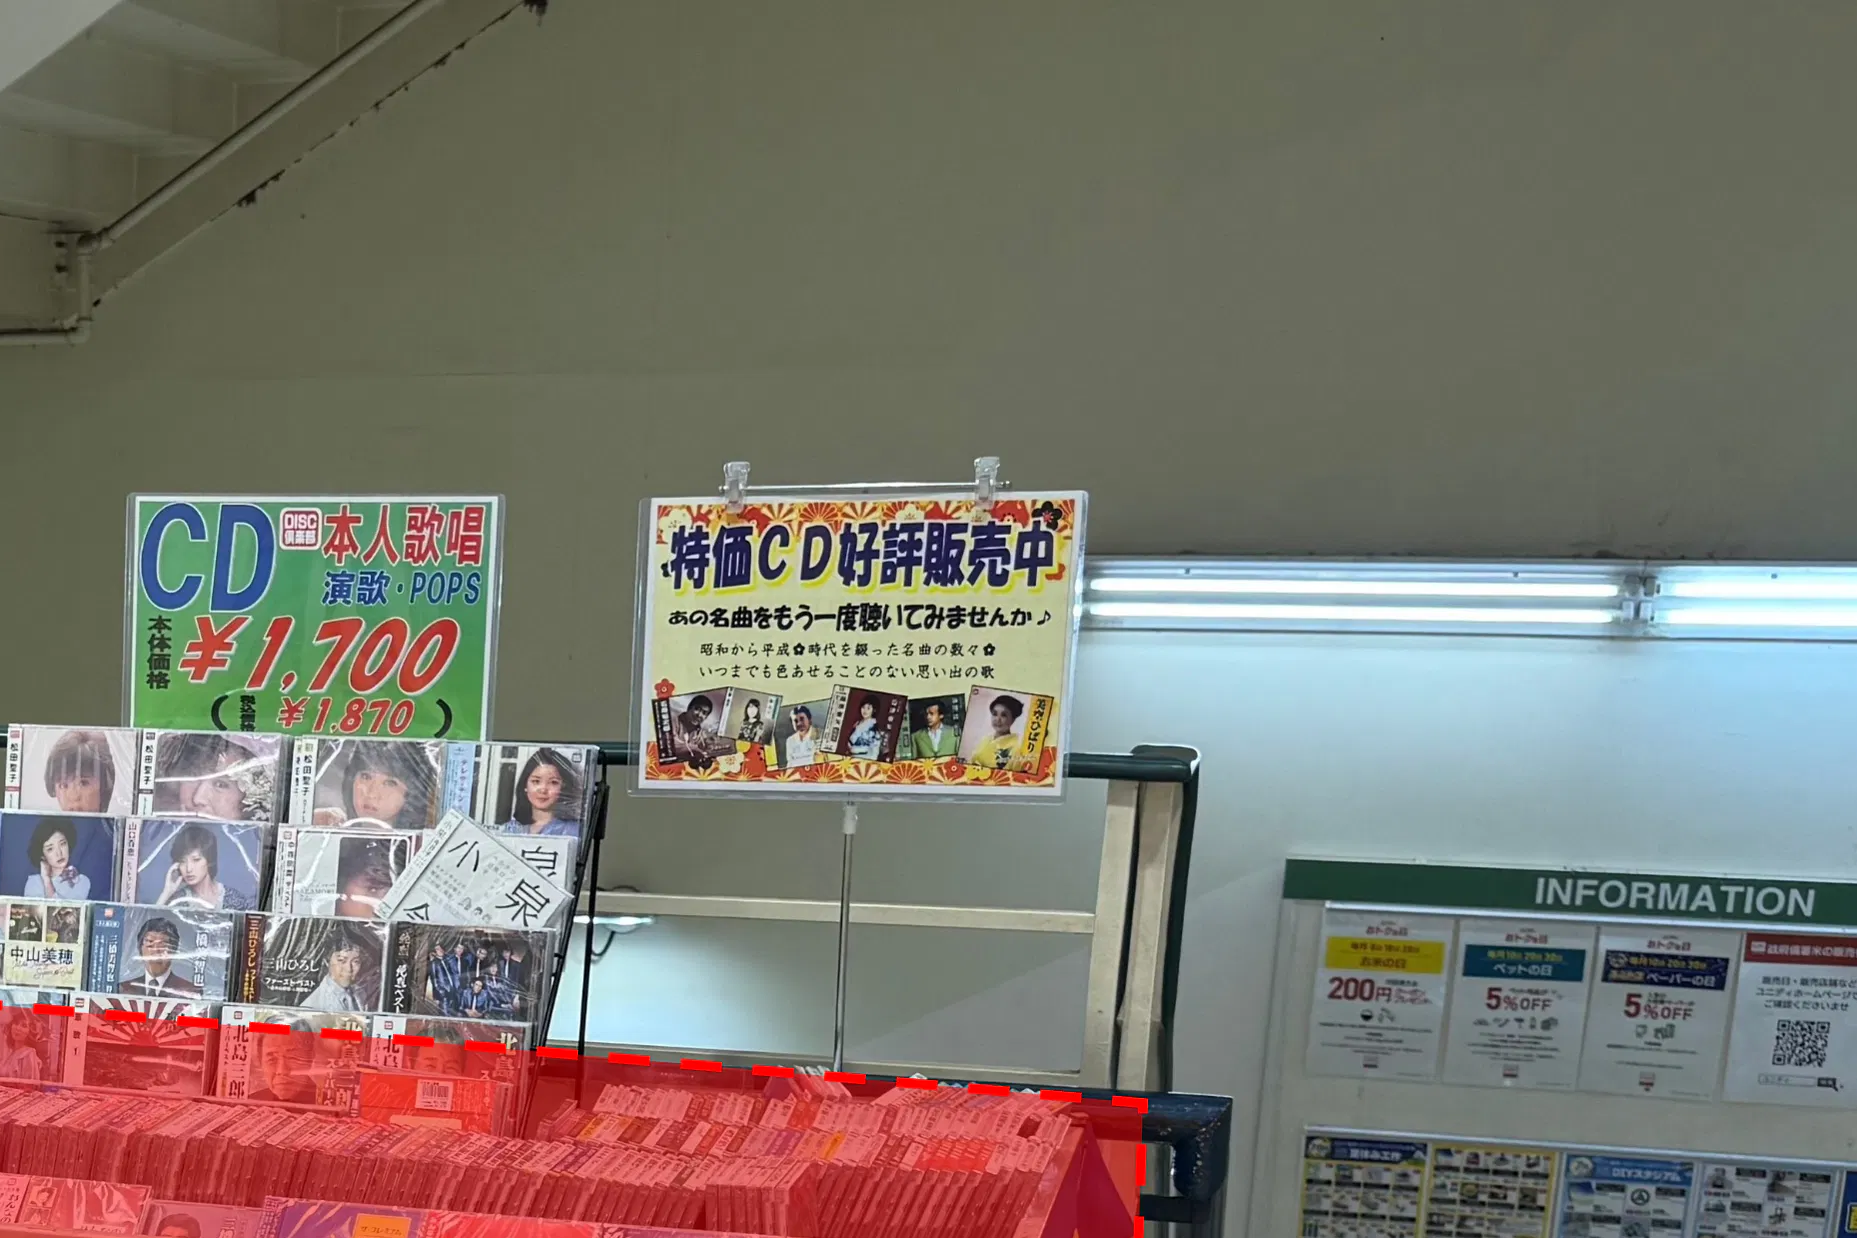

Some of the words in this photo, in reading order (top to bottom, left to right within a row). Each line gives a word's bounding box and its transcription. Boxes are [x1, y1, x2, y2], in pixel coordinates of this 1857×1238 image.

[284, 511, 317, 529] DISC
[322, 504, 487, 567] 本人歌唱
[140, 502, 276, 613] CD
[668, 521, 1055, 590] 特価CD好評販売中
[146, 615, 172, 690] 本体価格
[178, 615, 461, 696] ¥1,700
[699, 664, 995, 680] いつまでも色あせることのない思い出の歌
[1026, 698, 1050, 754] 美空ひばり
[1535, 876, 1816, 918] INFORMATION
[11, 946, 74, 965] 中山美穂
[263, 957, 320, 972] 三山ひろし
[1493, 963, 1553, 977] ペットの日
[1328, 976, 1392, 1003] 200円
[1647, 972, 1716, 988] ペーパーの日
